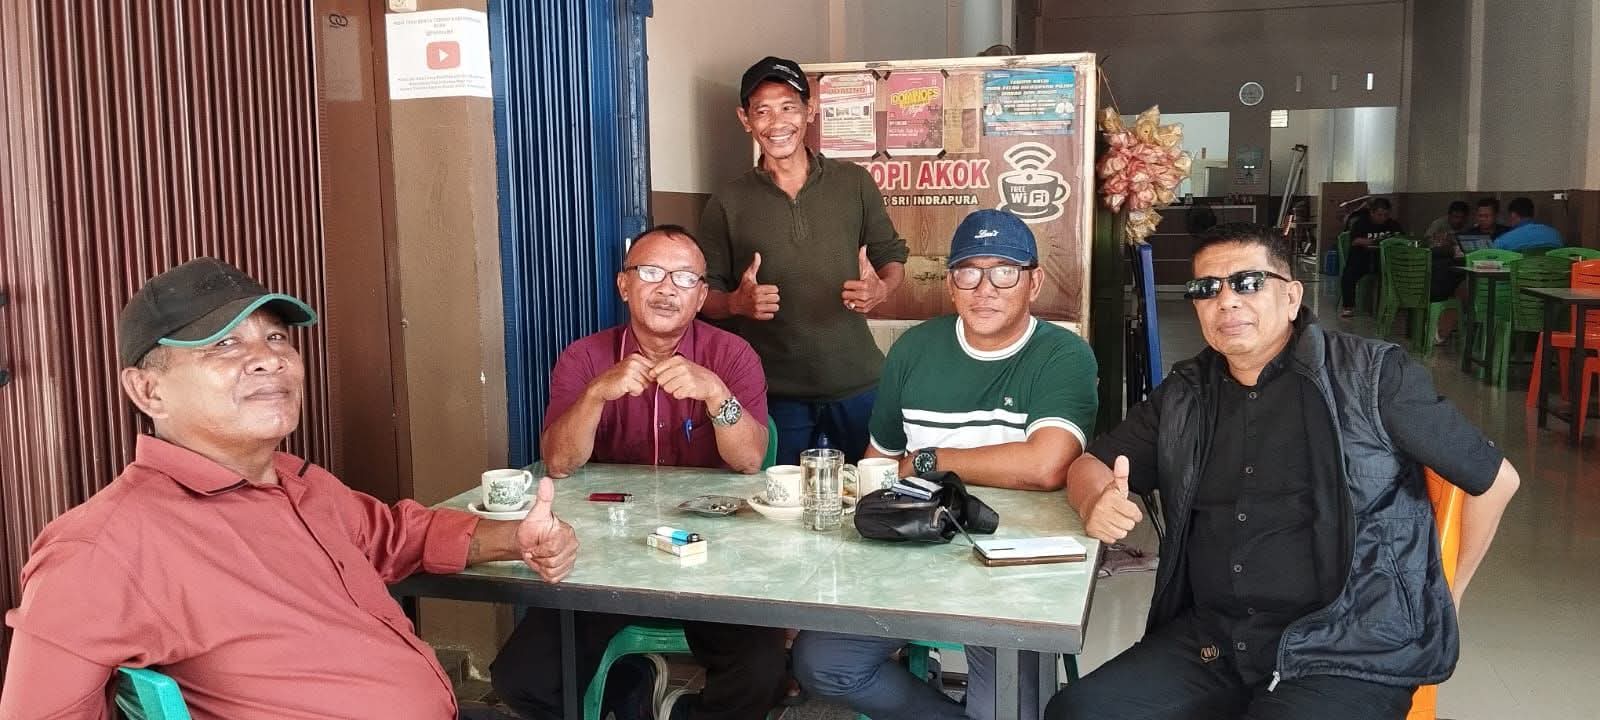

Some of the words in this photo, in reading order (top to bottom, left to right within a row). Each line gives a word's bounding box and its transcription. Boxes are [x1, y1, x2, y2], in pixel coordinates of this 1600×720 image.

[862, 161, 911, 190] OPI
[917, 160, 990, 190] AKOK
[1010, 185, 1027, 193] FREE
[891, 196, 910, 206] SRI
[913, 195, 979, 206] INDRAPURA
